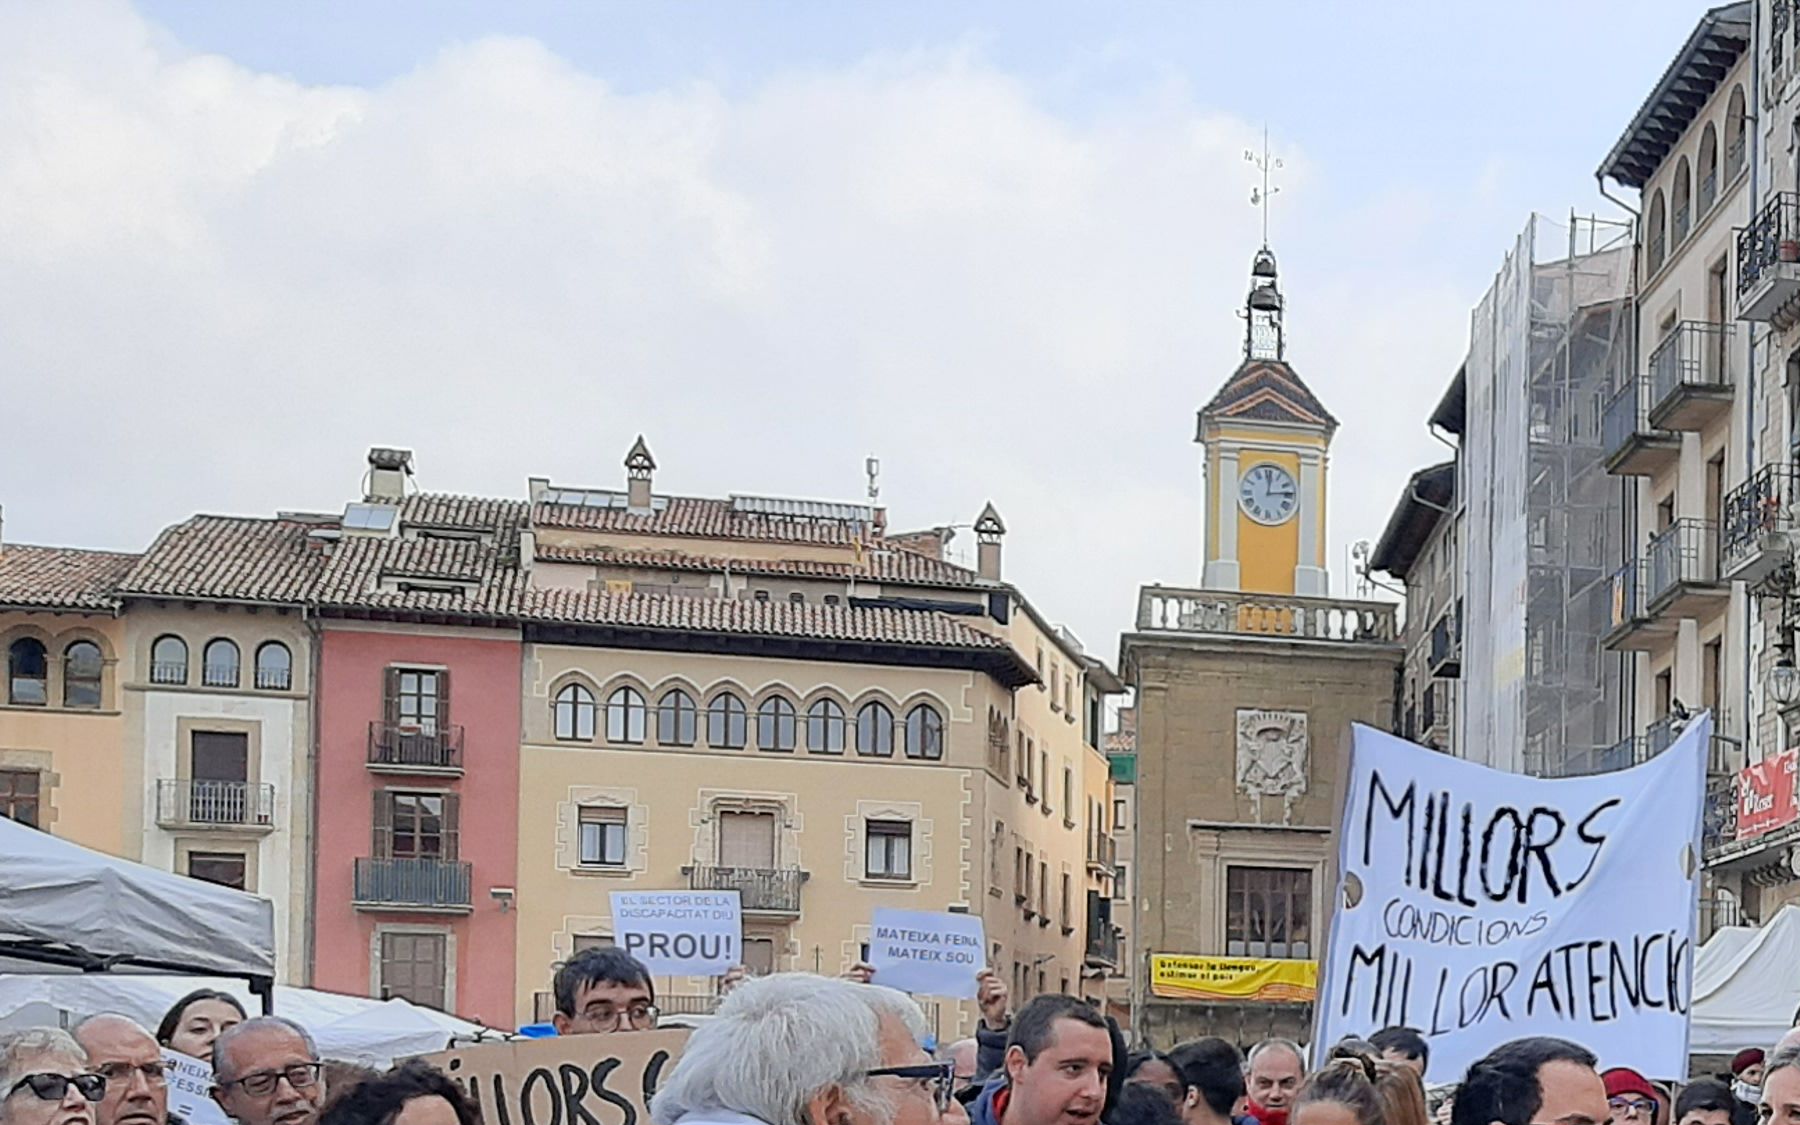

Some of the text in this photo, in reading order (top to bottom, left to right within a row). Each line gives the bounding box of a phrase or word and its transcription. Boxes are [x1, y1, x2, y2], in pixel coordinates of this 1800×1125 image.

[1363, 769, 1622, 907] MILLORS
[876, 927, 940, 944] MATEIXA
[1383, 898, 1548, 946] CONDICIONS
[624, 932, 732, 960] PROU!
[888, 945, 975, 964] MATEIX SOU
[1342, 944, 1519, 1036] MILLOR
